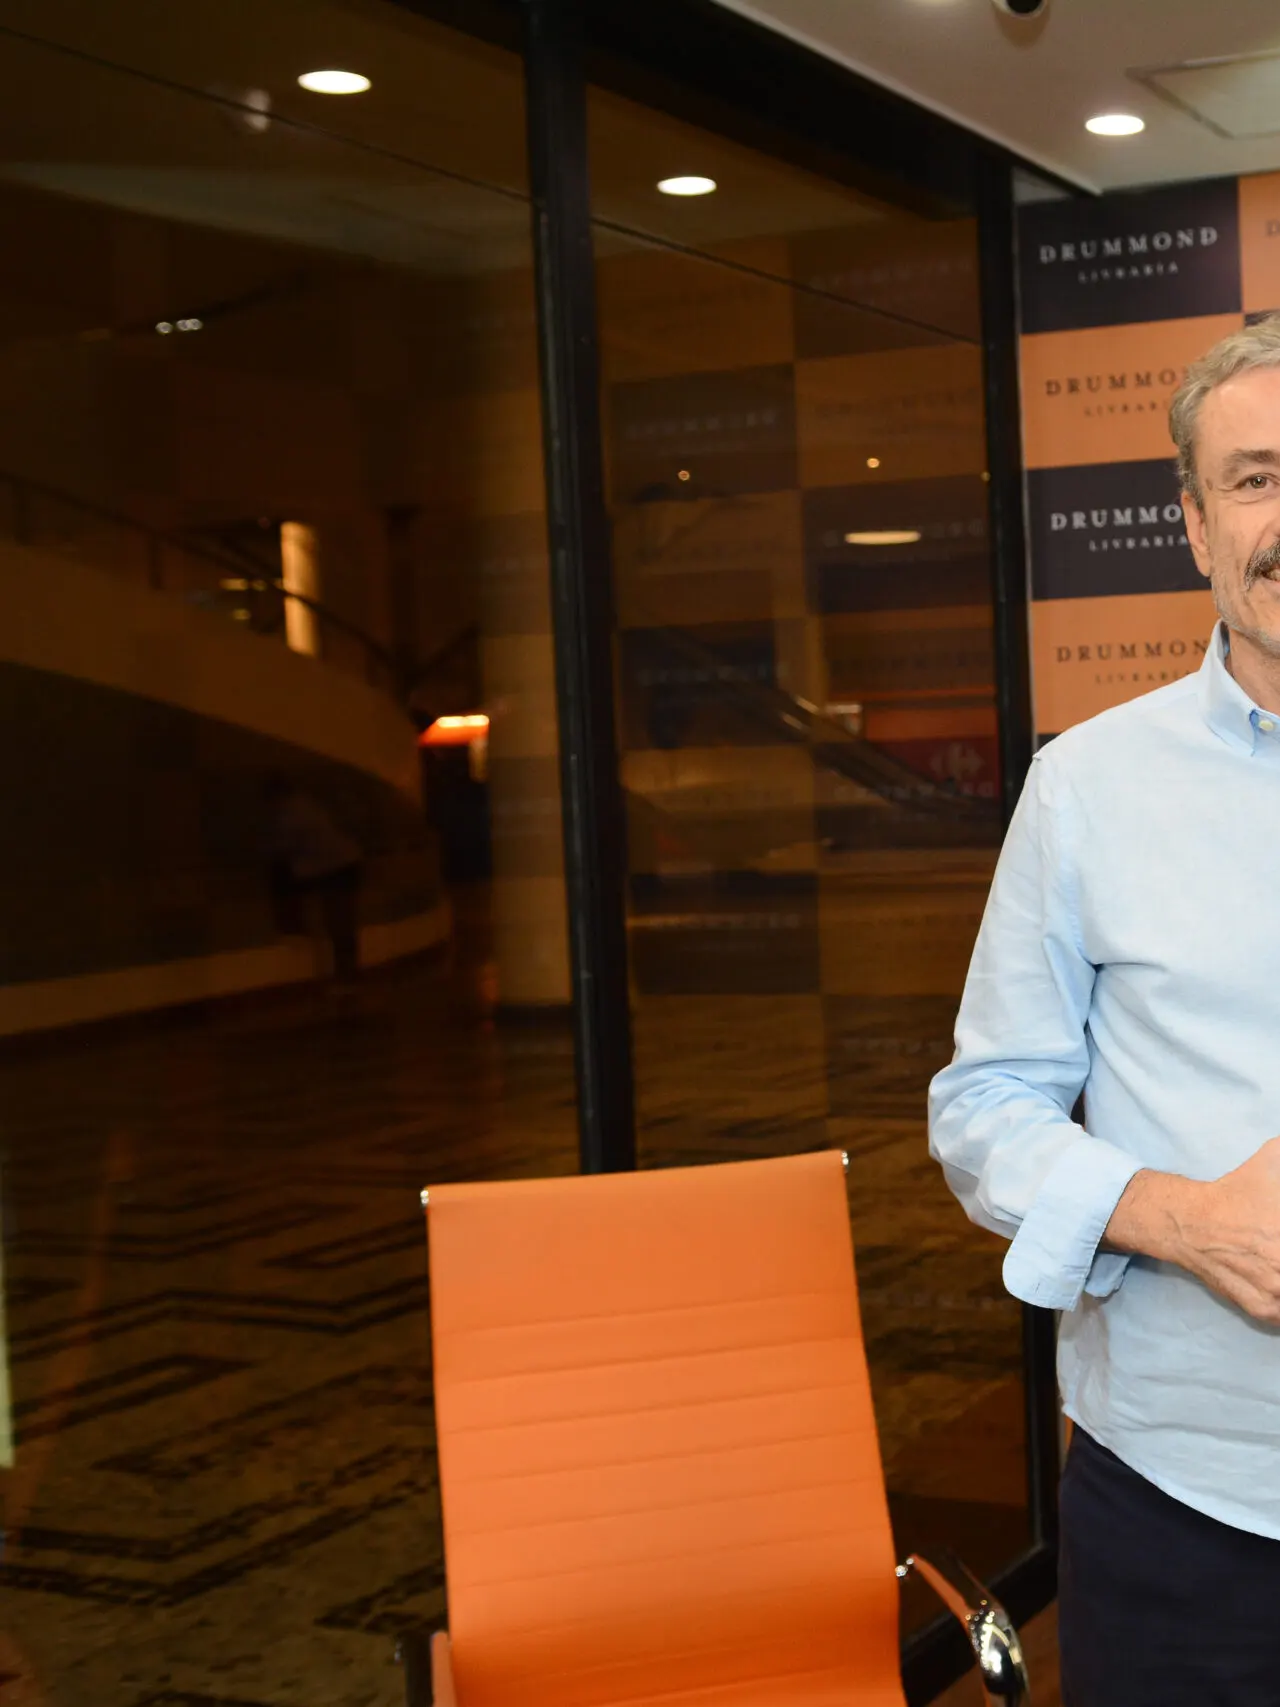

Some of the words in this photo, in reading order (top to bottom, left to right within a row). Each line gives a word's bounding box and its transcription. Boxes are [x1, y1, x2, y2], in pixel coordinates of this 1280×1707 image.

[1039, 226, 1218, 264] DRUMMOND
[1078, 261, 1178, 283] LIVRARIA
[1045, 369, 1186, 396] DRUMMO
